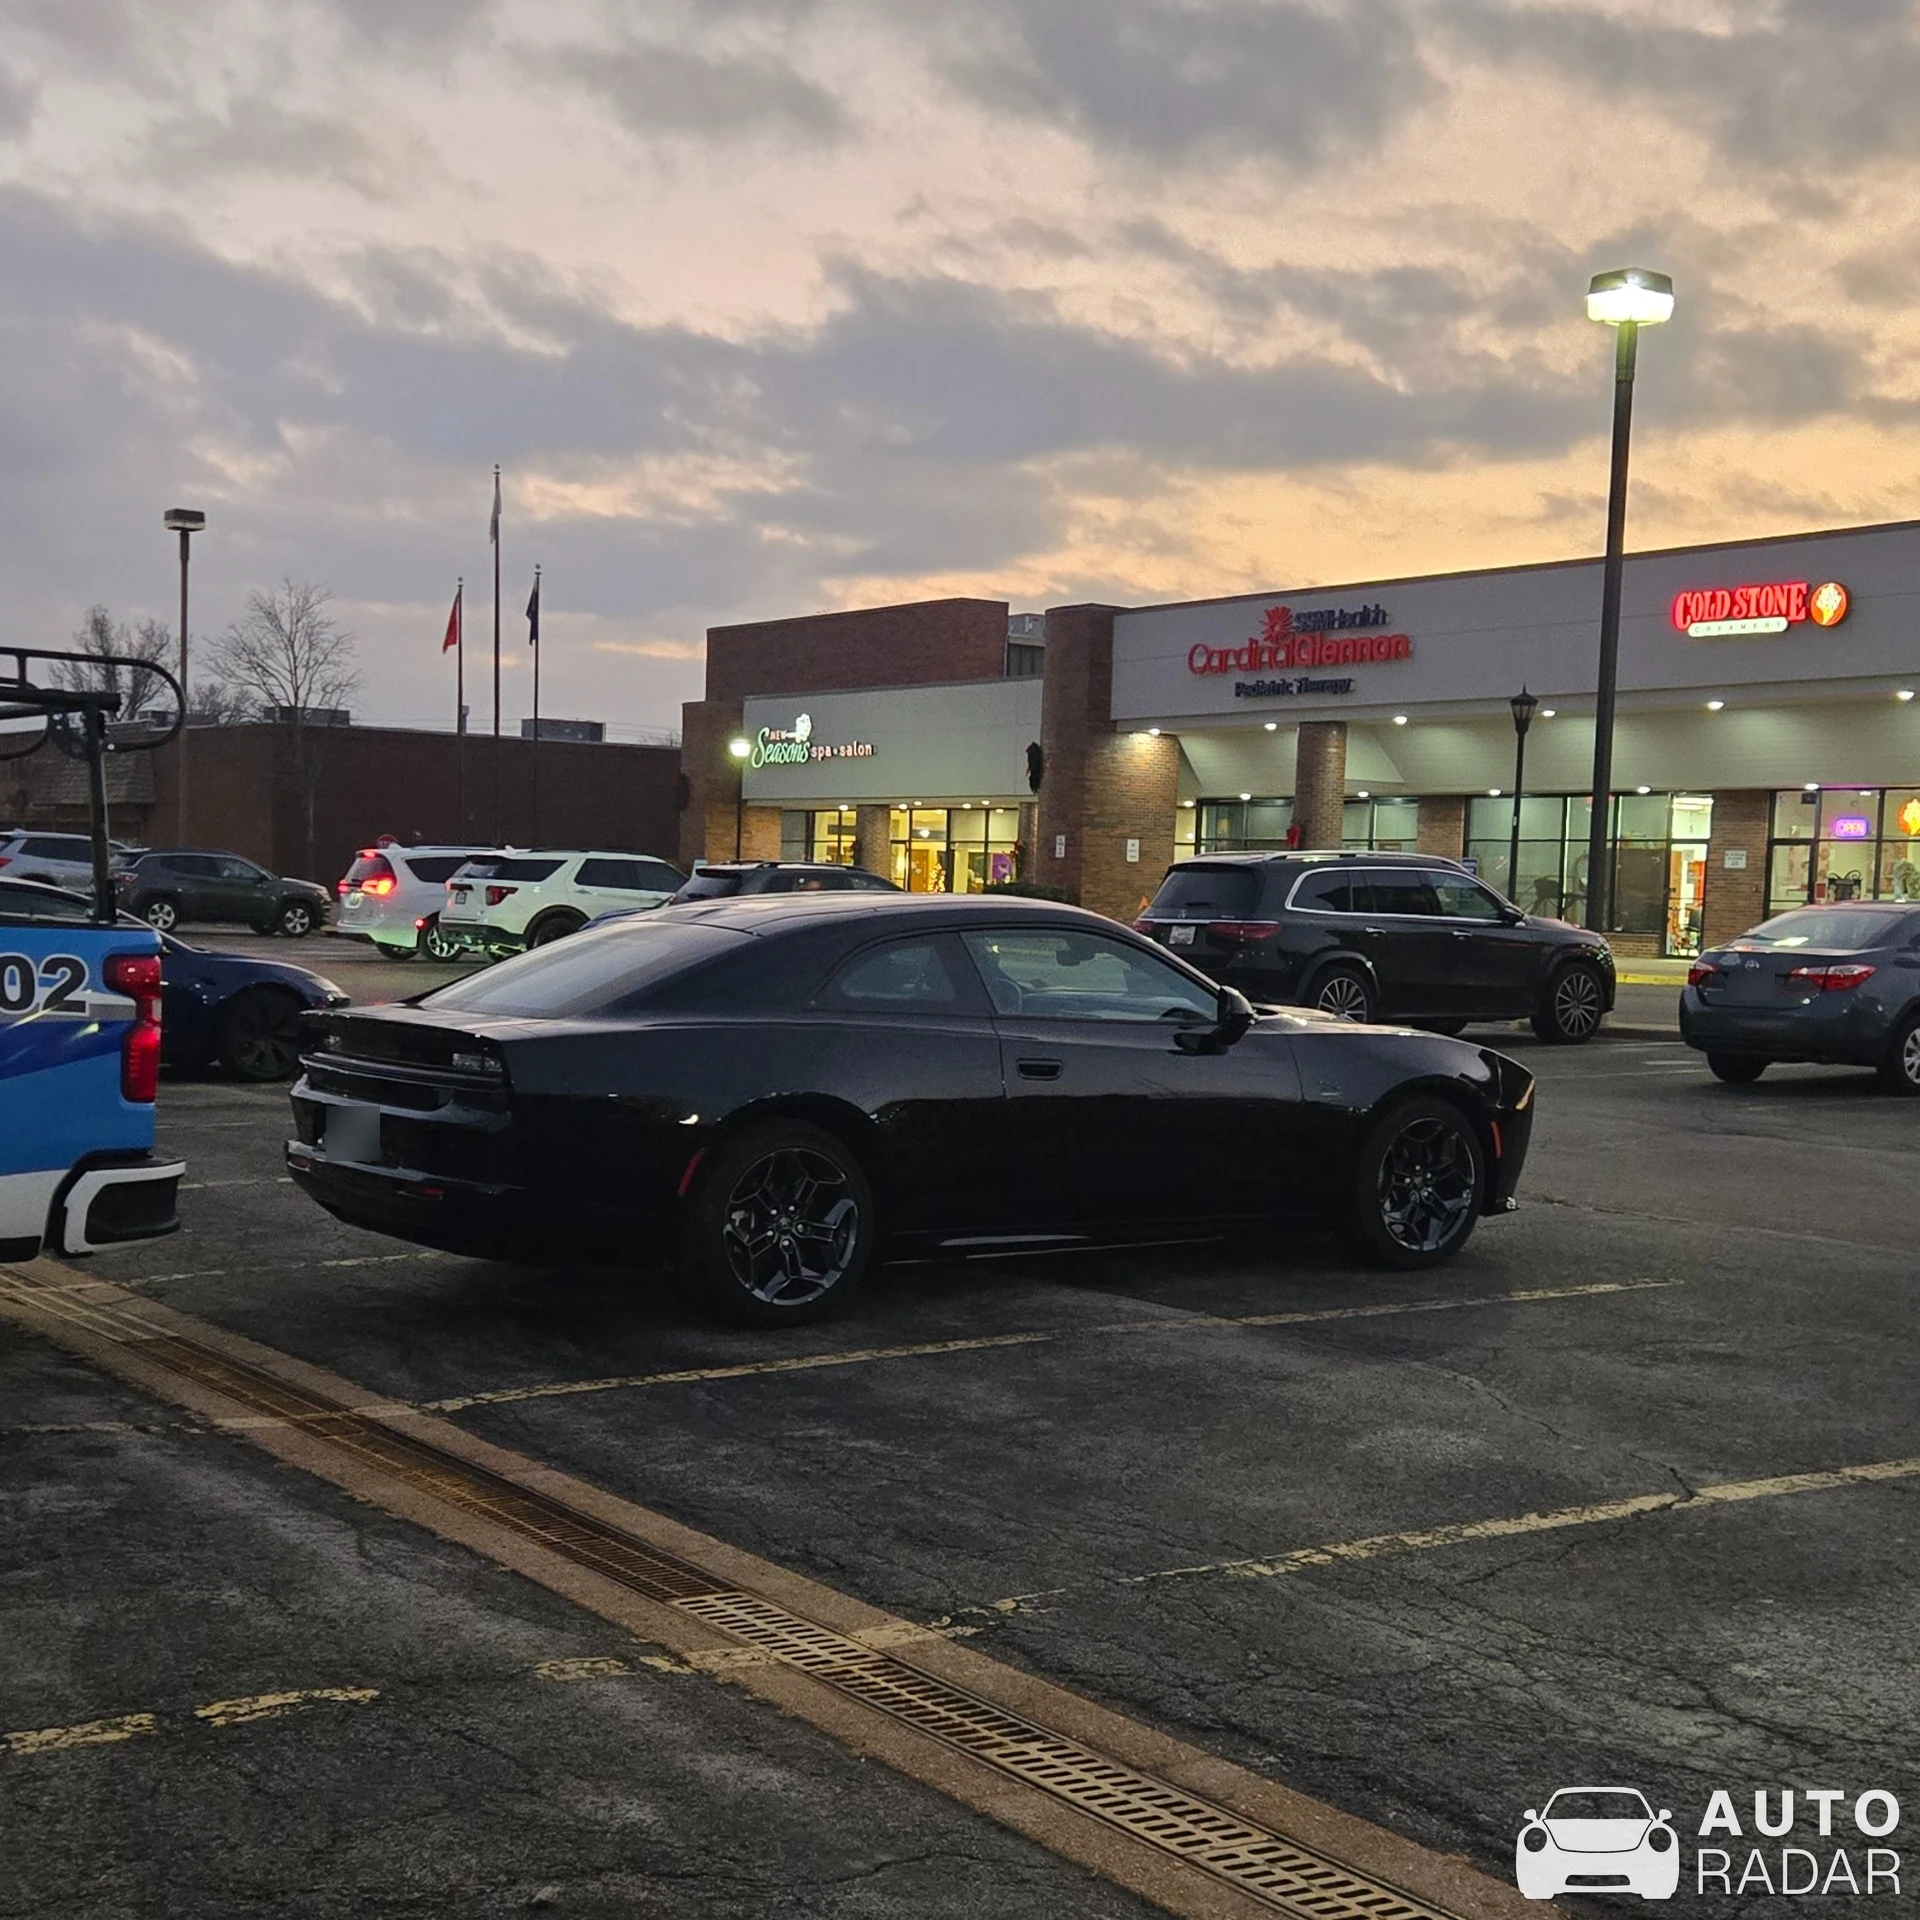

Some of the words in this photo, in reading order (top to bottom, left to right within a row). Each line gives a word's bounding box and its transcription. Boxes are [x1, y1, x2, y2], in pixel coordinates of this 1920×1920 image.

[1673, 590, 1731, 630] COLD
[1732, 582, 1808, 622] STONE
[1694, 621, 1782, 633] CREAMERY
[1294, 631, 1411, 666] Glennon
[751, 727, 810, 768] Seasons
[811, 745, 832, 761] spa
[839, 741, 872, 757] salon
